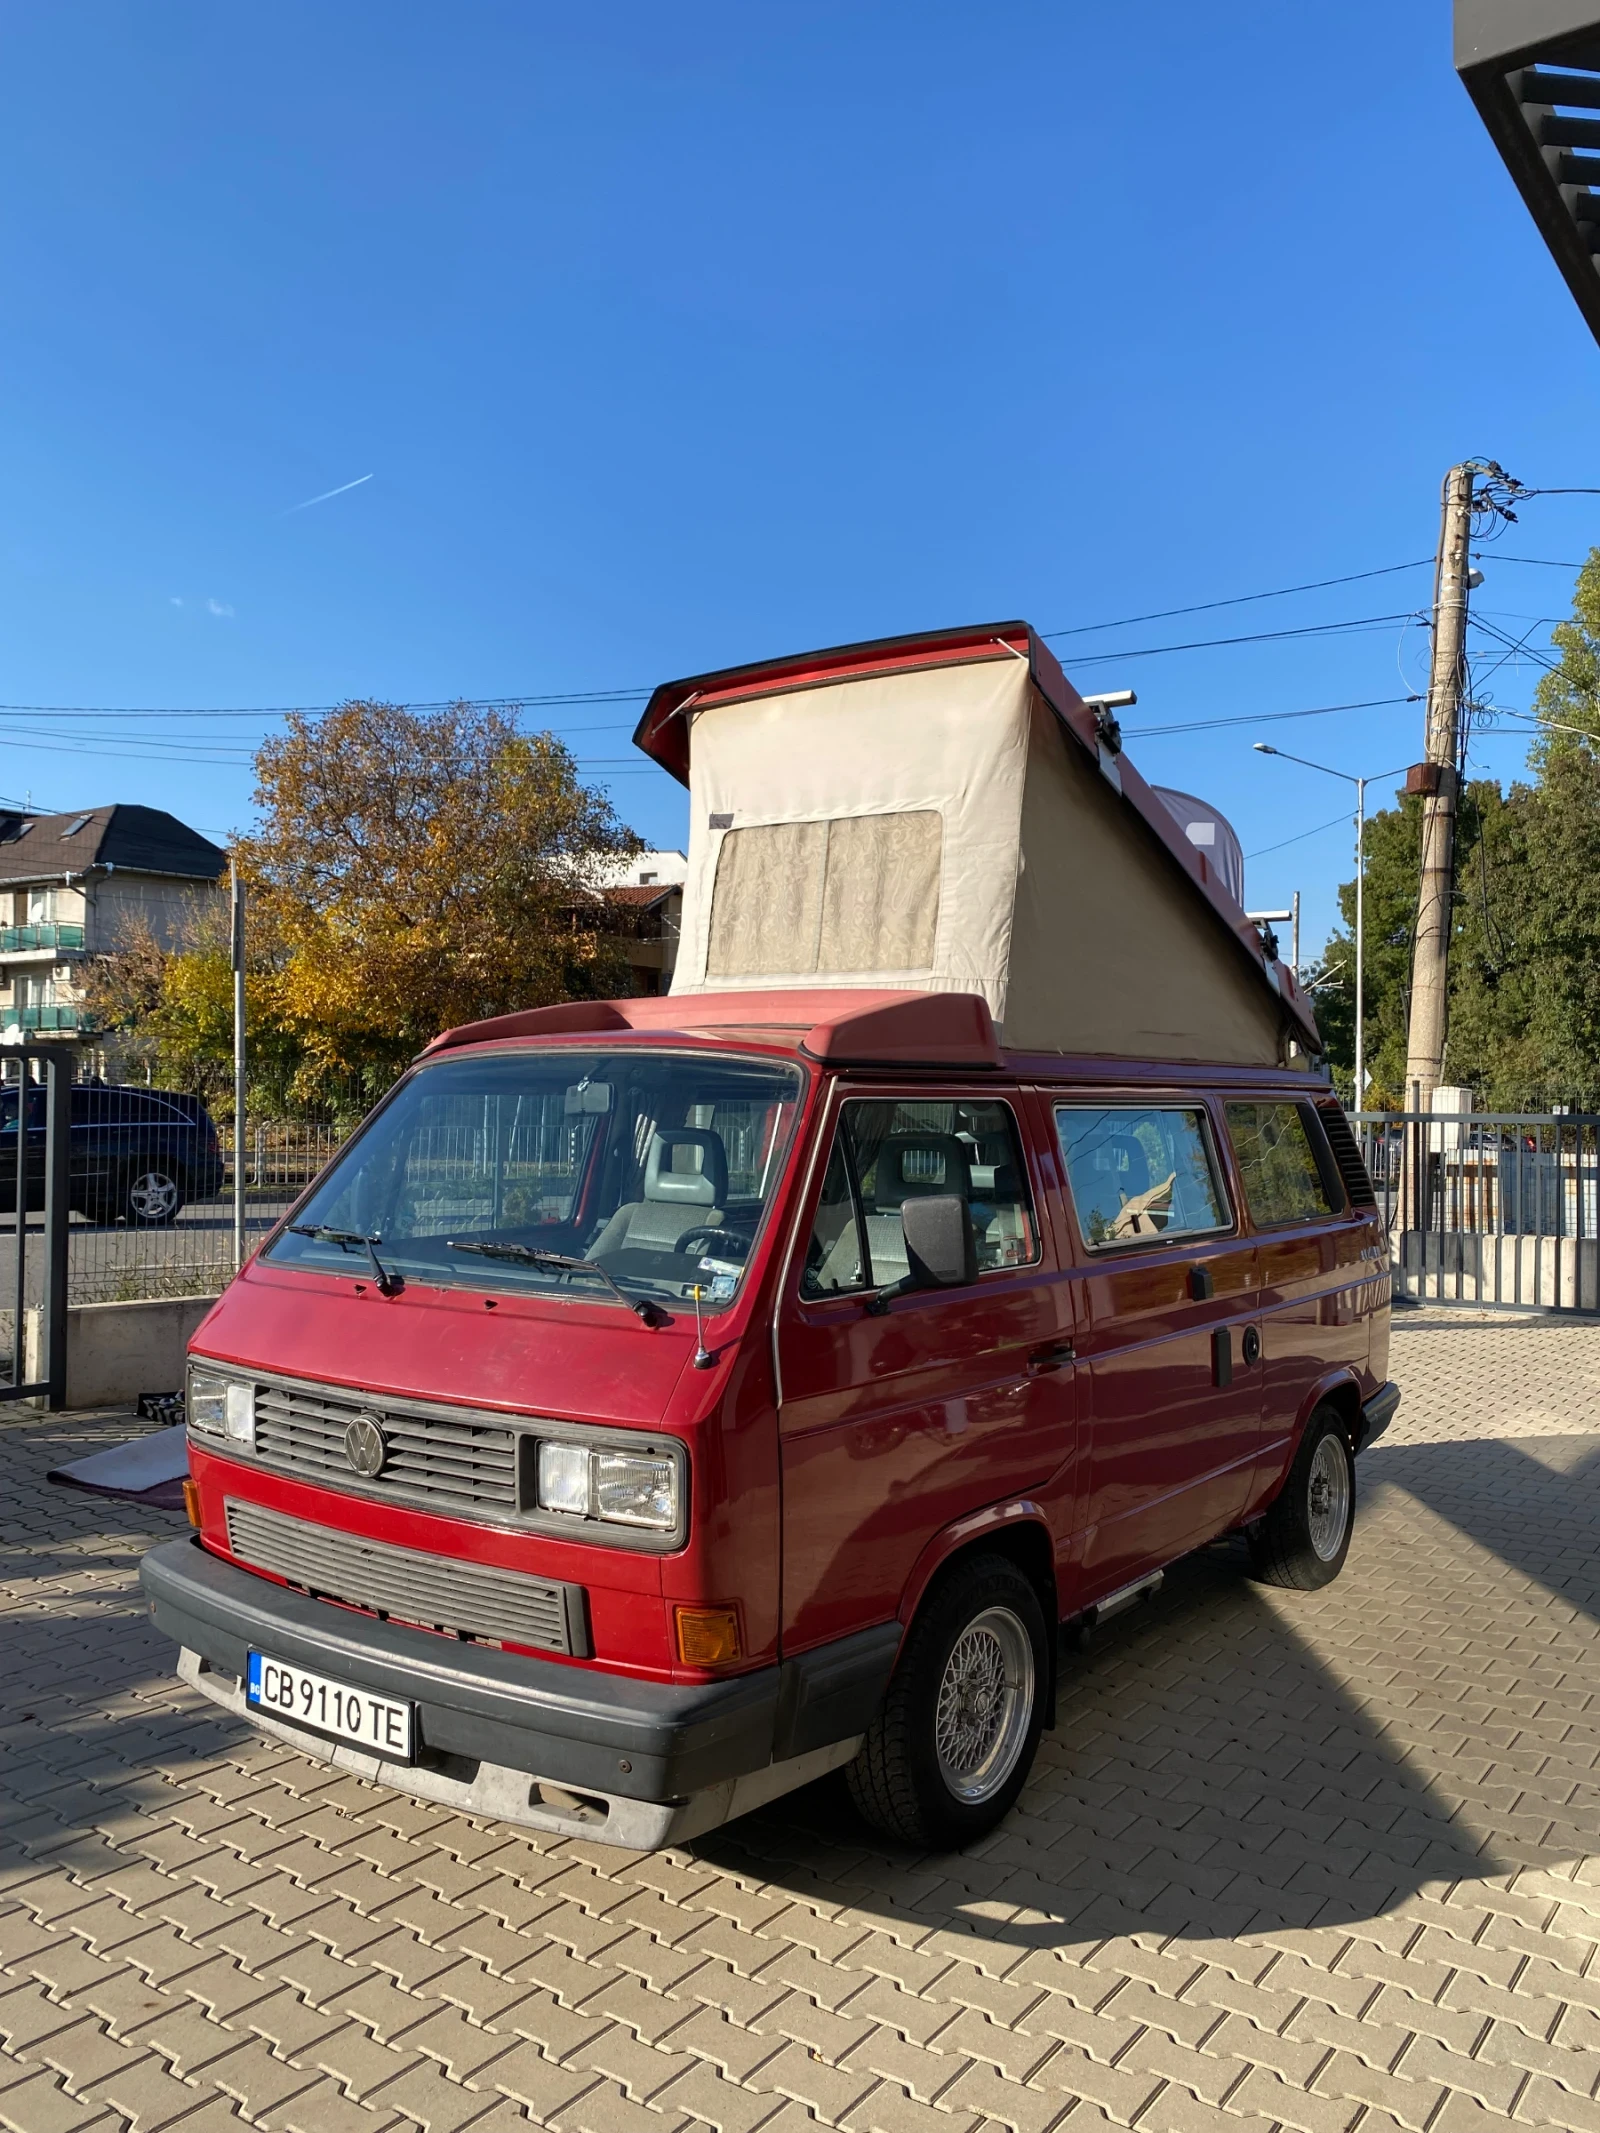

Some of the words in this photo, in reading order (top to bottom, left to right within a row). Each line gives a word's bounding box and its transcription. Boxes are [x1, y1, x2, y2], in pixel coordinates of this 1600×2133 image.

[345, 1419, 382, 1477] VW
[250, 1681, 260, 1696] BG
[264, 1665, 295, 1709] CB
[300, 1678, 362, 1734] 9110
[368, 1700, 404, 1750] TE
